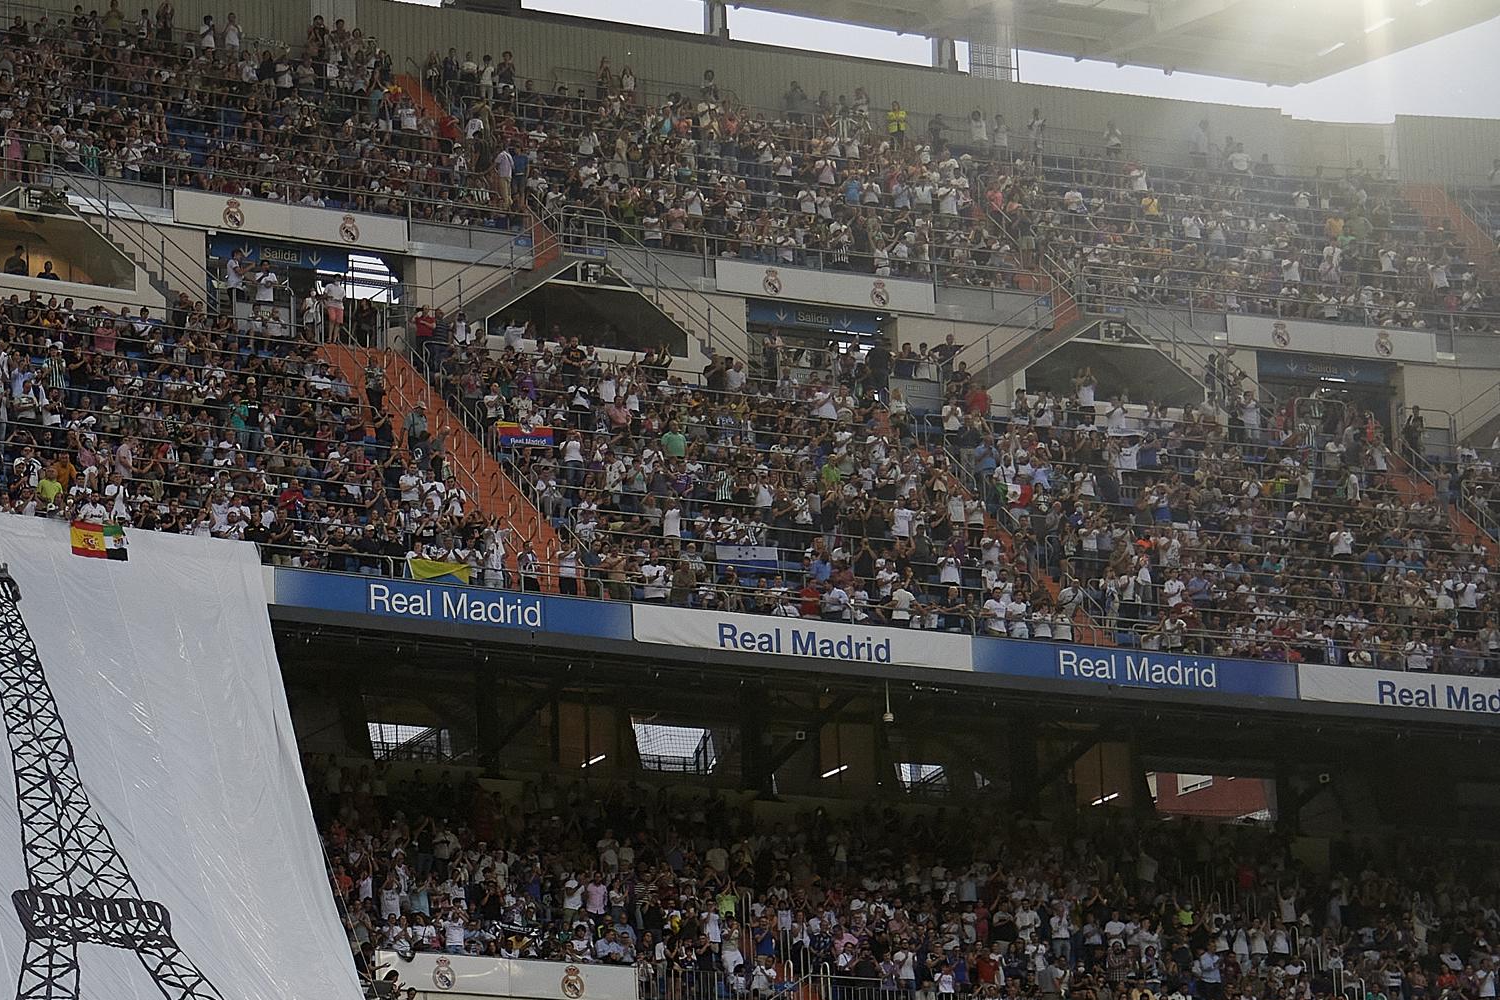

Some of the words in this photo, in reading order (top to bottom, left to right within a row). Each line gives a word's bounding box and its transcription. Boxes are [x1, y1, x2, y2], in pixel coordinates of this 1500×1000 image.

[263, 247, 298, 262] Salida
[797, 311, 830, 325] Salida
[369, 583, 432, 616] Real
[442, 591, 541, 627] Madrid
[718, 622, 781, 654] Real
[791, 629, 891, 663] Madrid
[1059, 649, 1116, 680] Real
[1125, 655, 1217, 688] Madrid
[1377, 680, 1437, 708] Real
